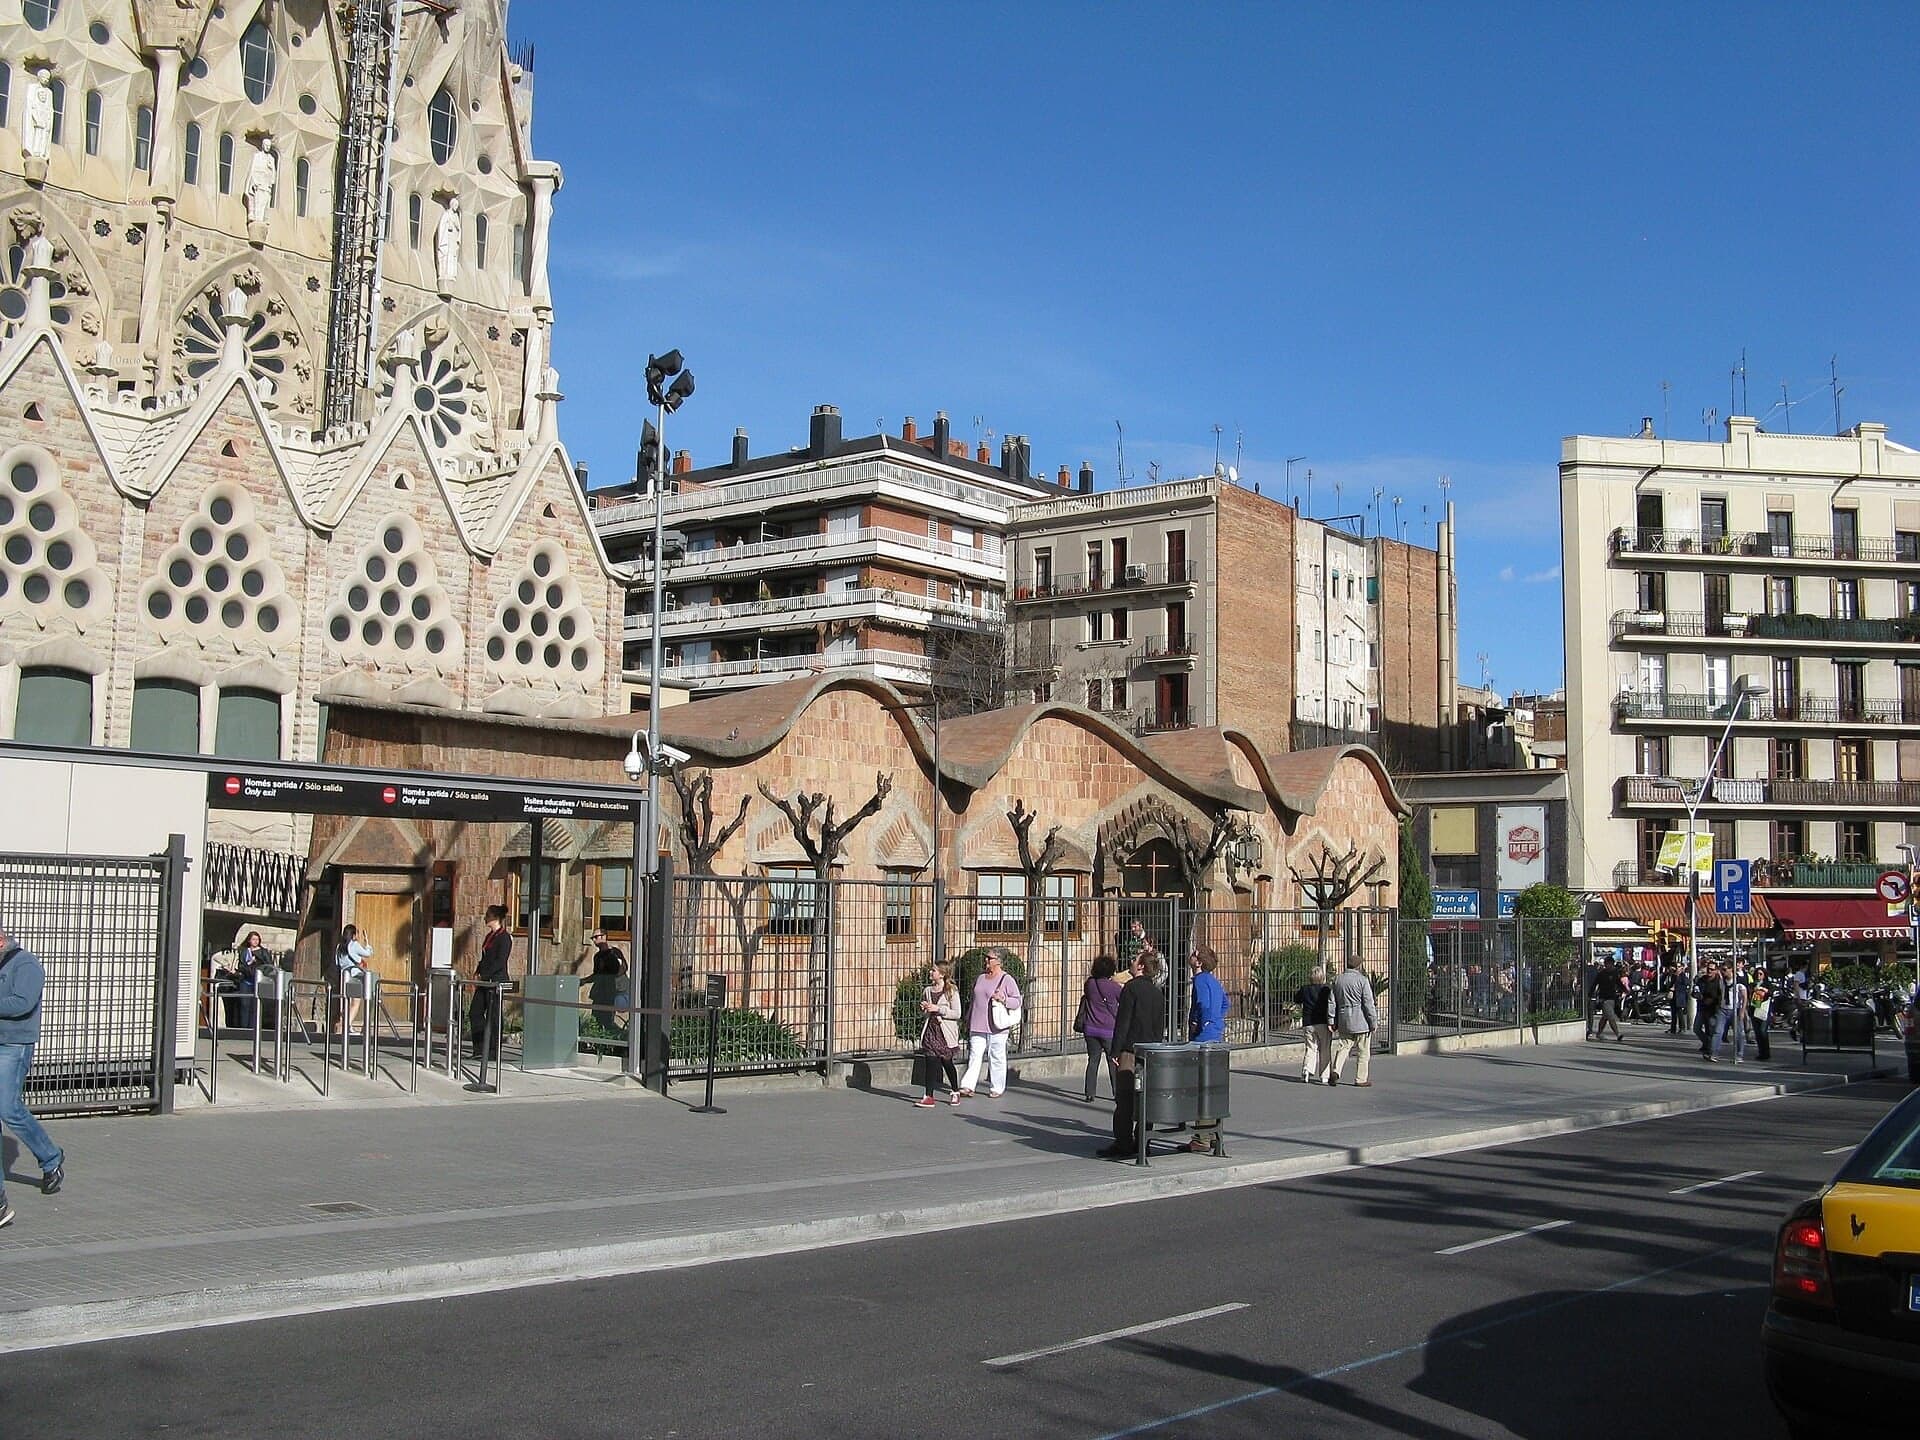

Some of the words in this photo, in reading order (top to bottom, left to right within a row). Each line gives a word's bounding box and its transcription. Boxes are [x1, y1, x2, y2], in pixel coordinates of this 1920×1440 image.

[245, 778, 271, 788] Només
[272, 780, 298, 789] sortida
[304, 782, 321, 791] Sólo
[322, 784, 344, 792] salida
[244, 787, 262, 798] Only
[263, 789, 277, 797] exit
[402, 787, 426, 796] Només
[426, 789, 450, 798] sortida
[455, 790, 470, 800] Sólo
[470, 792, 490, 800] salida
[402, 796, 417, 806] Only
[524, 796, 544, 805] Visites
[544, 799, 576, 808] educatives
[580, 800, 599, 809] Visitas
[524, 804, 558, 814] Educational
[1721, 864, 1743, 892] P
[1436, 894, 1455, 902] Tren
[1458, 894, 1468, 902] de
[1436, 905, 1466, 913] Rentat
[1796, 930, 1852, 940] SNACK
